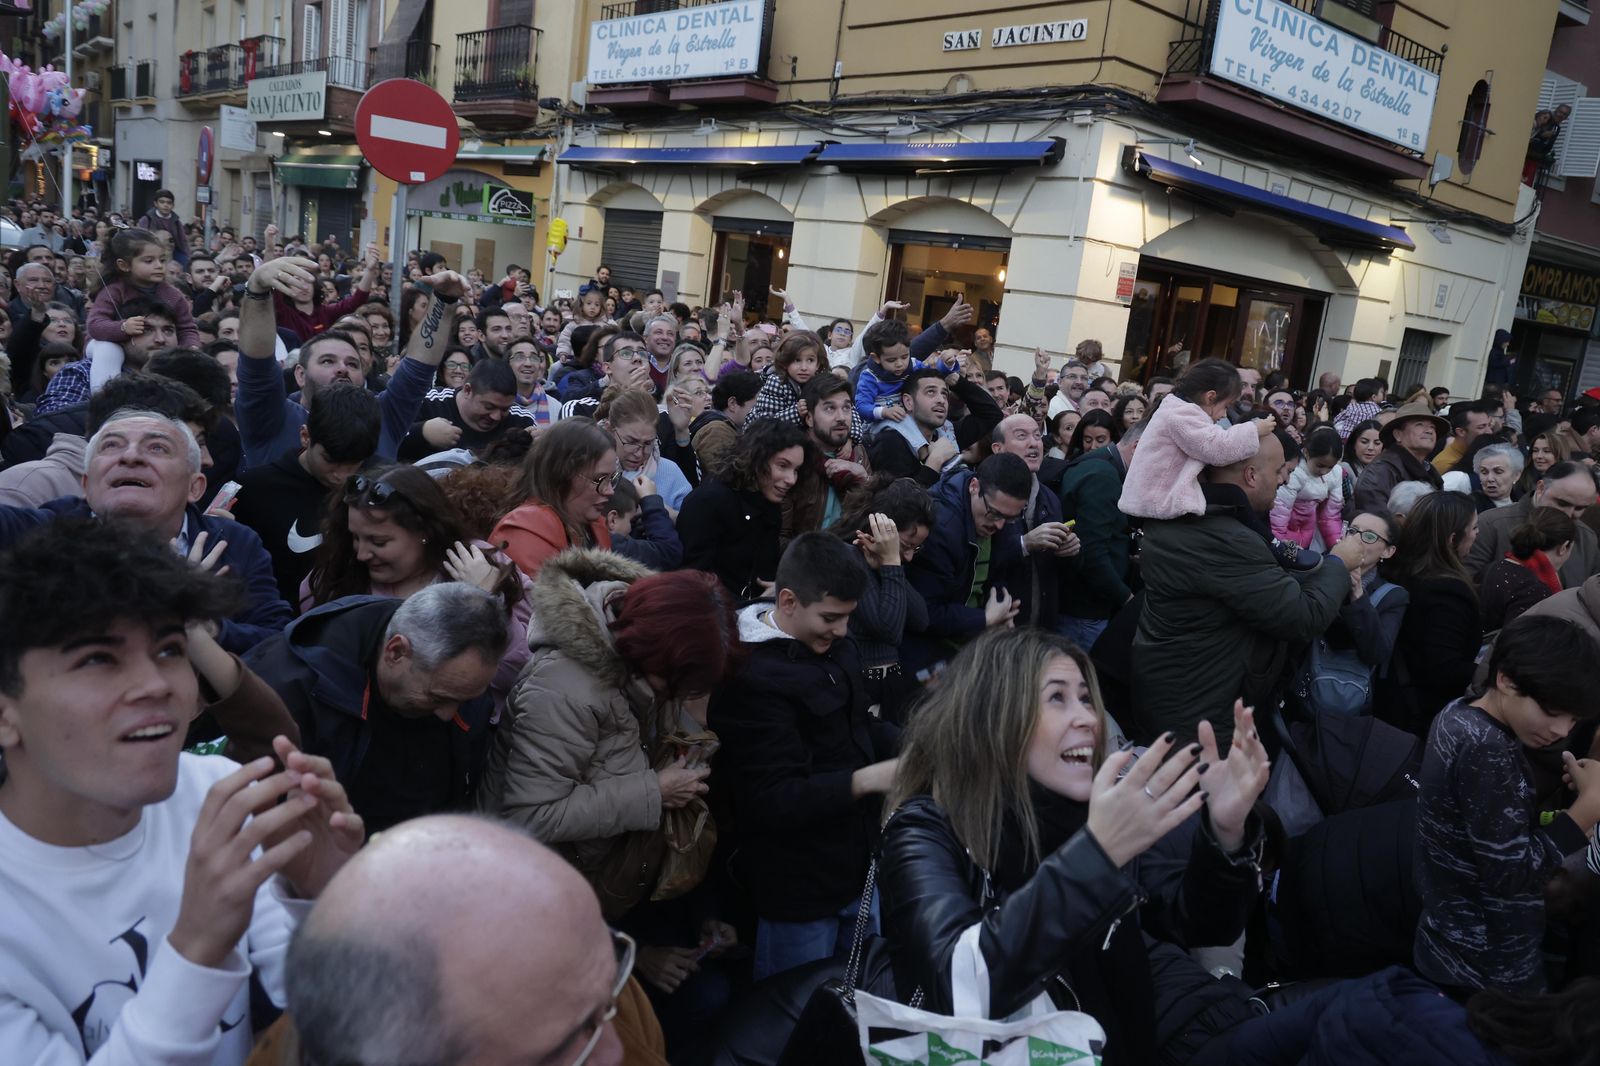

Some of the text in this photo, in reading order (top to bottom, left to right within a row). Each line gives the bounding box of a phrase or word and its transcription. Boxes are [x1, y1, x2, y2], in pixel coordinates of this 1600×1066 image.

[597, 5, 754, 40] CLINICA DENTAL
[943, 22, 1085, 49] SAN JACINTO
[608, 28, 736, 66] Virgen de la Estrella
[269, 79, 302, 92] CALZADOS
[594, 68, 625, 80] TELF.
[632, 63, 690, 77] 4344207
[739, 58, 749, 70] B
[1249, 26, 1412, 116] Virgen de la Estrella
[1351, 44, 1429, 96] DENTAL
[1224, 57, 1276, 91] TELF.
[1411, 132, 1420, 145] B
[499, 201, 522, 210] PIZZA
[1522, 262, 1600, 306] OMPRAMOS
